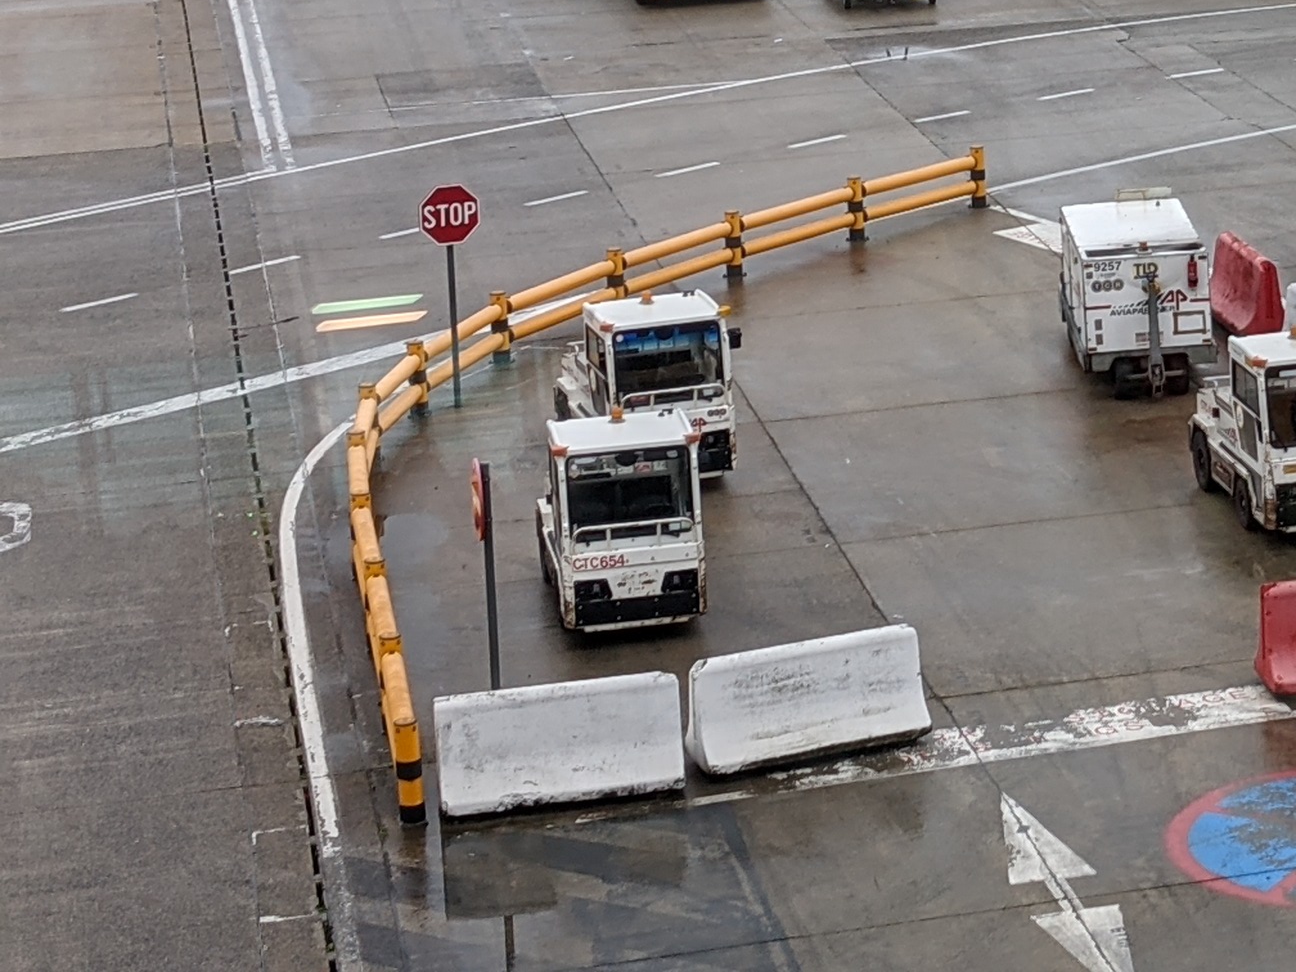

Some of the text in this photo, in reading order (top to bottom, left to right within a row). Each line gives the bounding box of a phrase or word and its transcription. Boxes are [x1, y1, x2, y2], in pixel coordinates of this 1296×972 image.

[423, 201, 477, 229] STOP
[1094, 261, 1122, 272] 9257
[572, 554, 626, 570] CTC654
